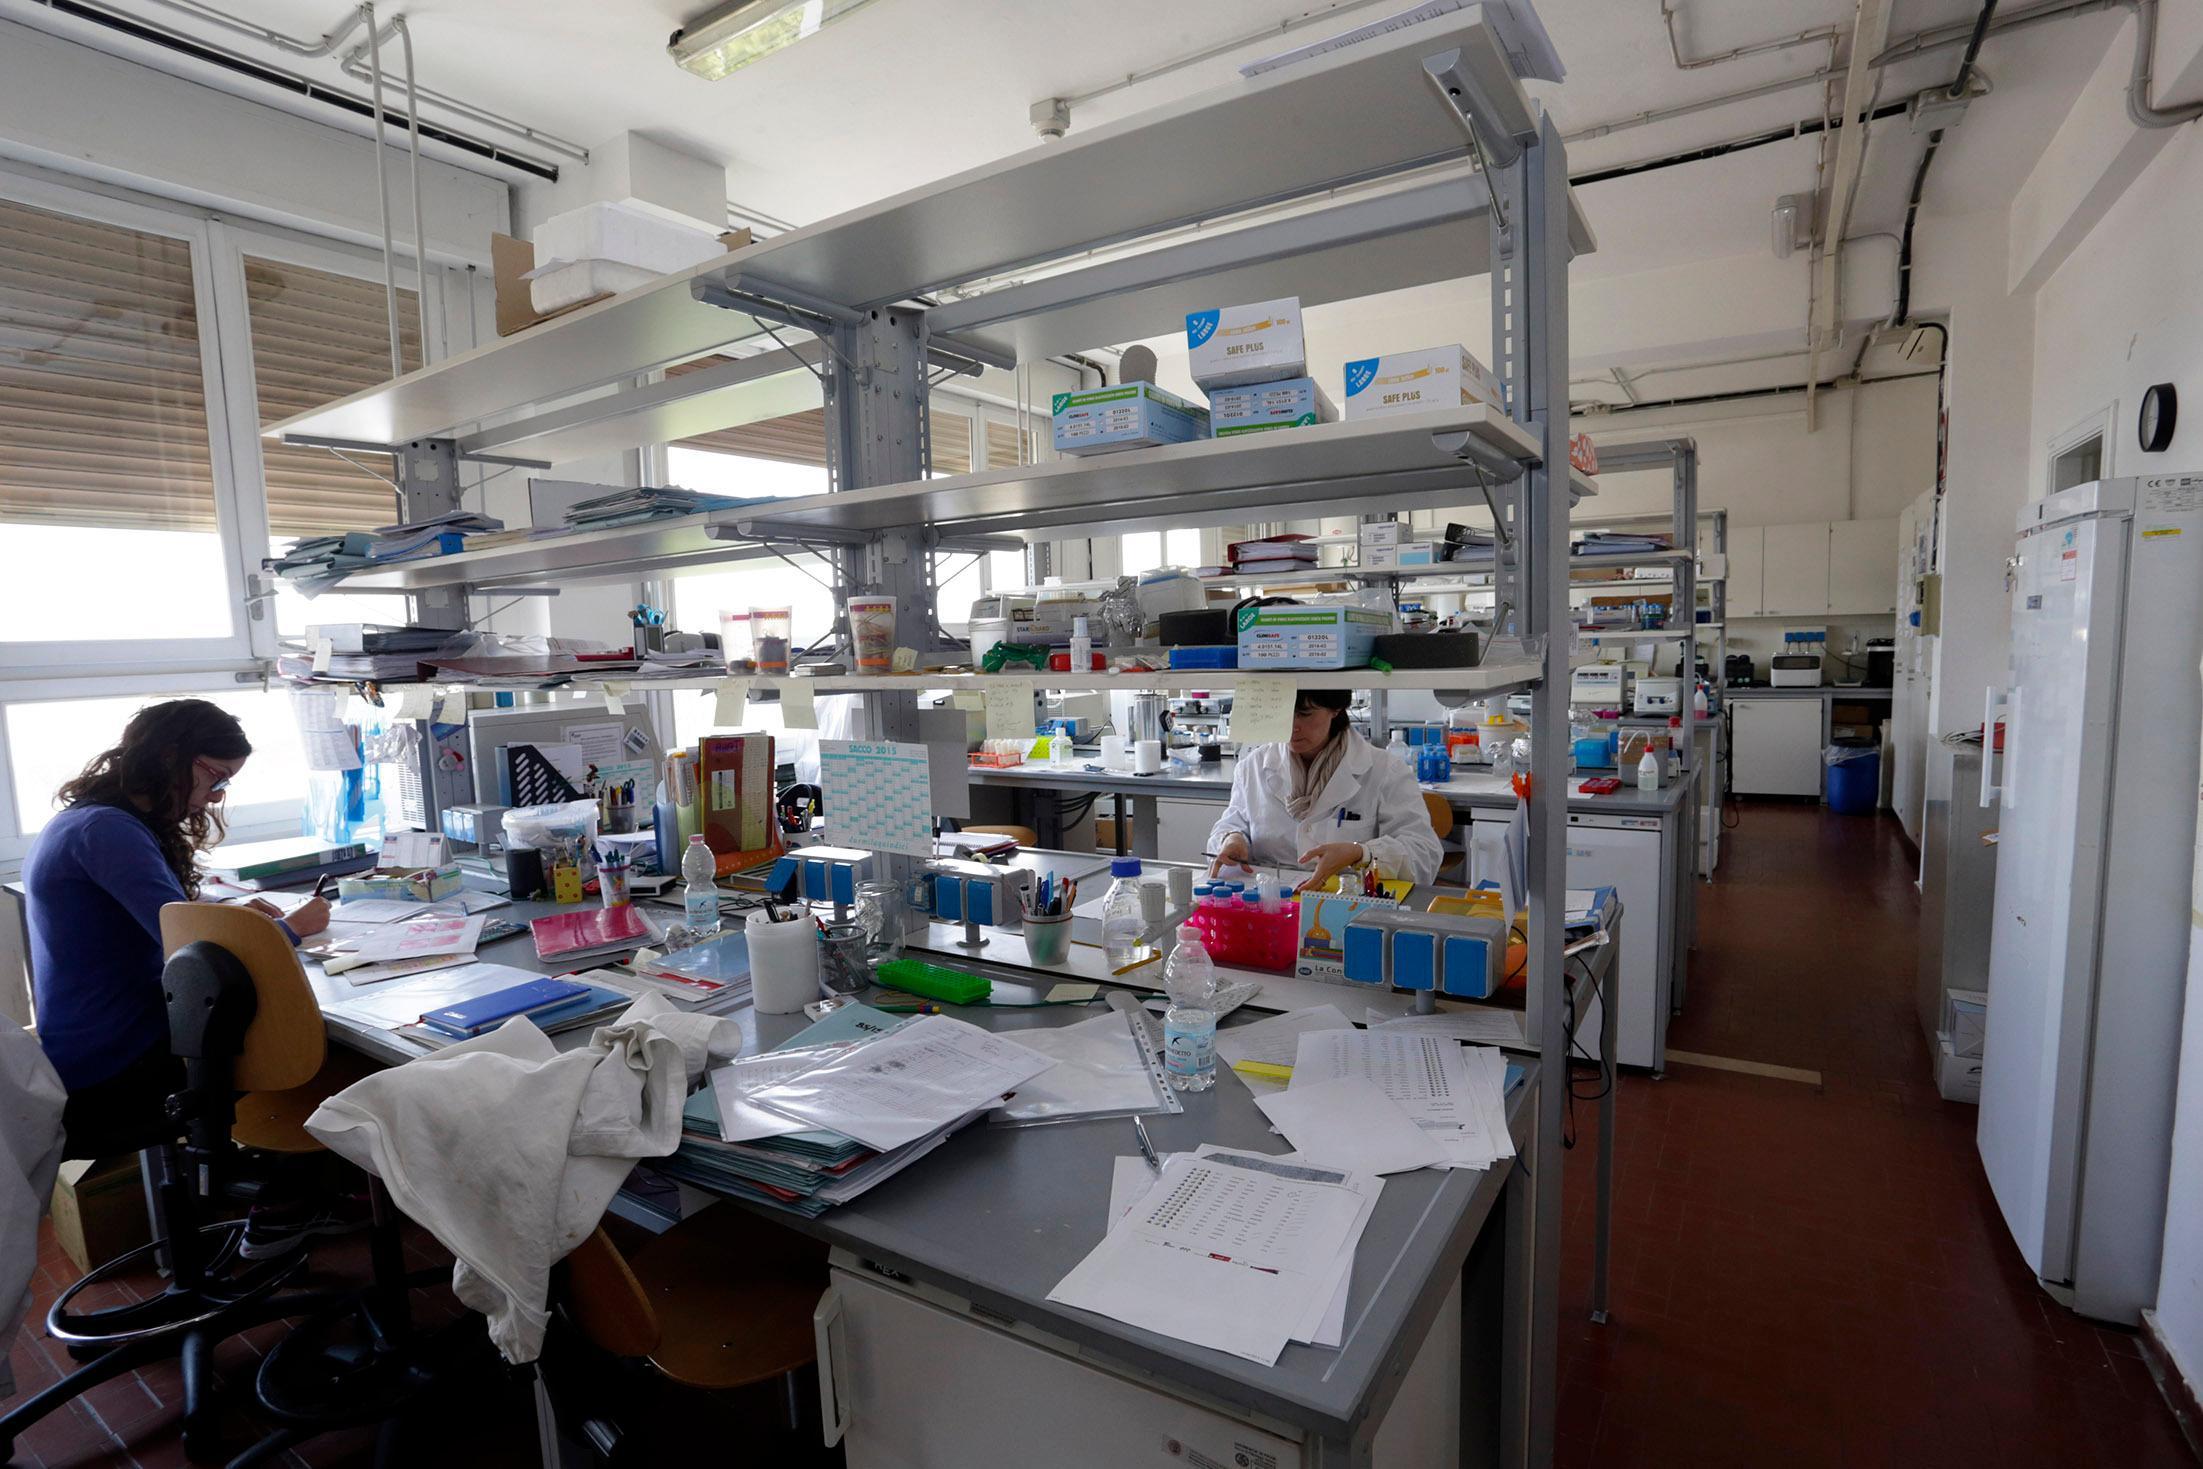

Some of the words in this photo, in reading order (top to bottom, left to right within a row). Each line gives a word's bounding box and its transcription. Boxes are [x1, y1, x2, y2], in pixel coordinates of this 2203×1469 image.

[1226, 344, 1244, 356] SAFE
[1245, 342, 1264, 353] PLUS
[1382, 393, 1401, 404] SAFE
[1402, 390, 1421, 401] PLUS
[1239, 612, 1256, 630] LARGE
[849, 744, 872, 754] SACCO
[876, 746, 897, 755] 2015
[1326, 966, 1342, 974] Con
